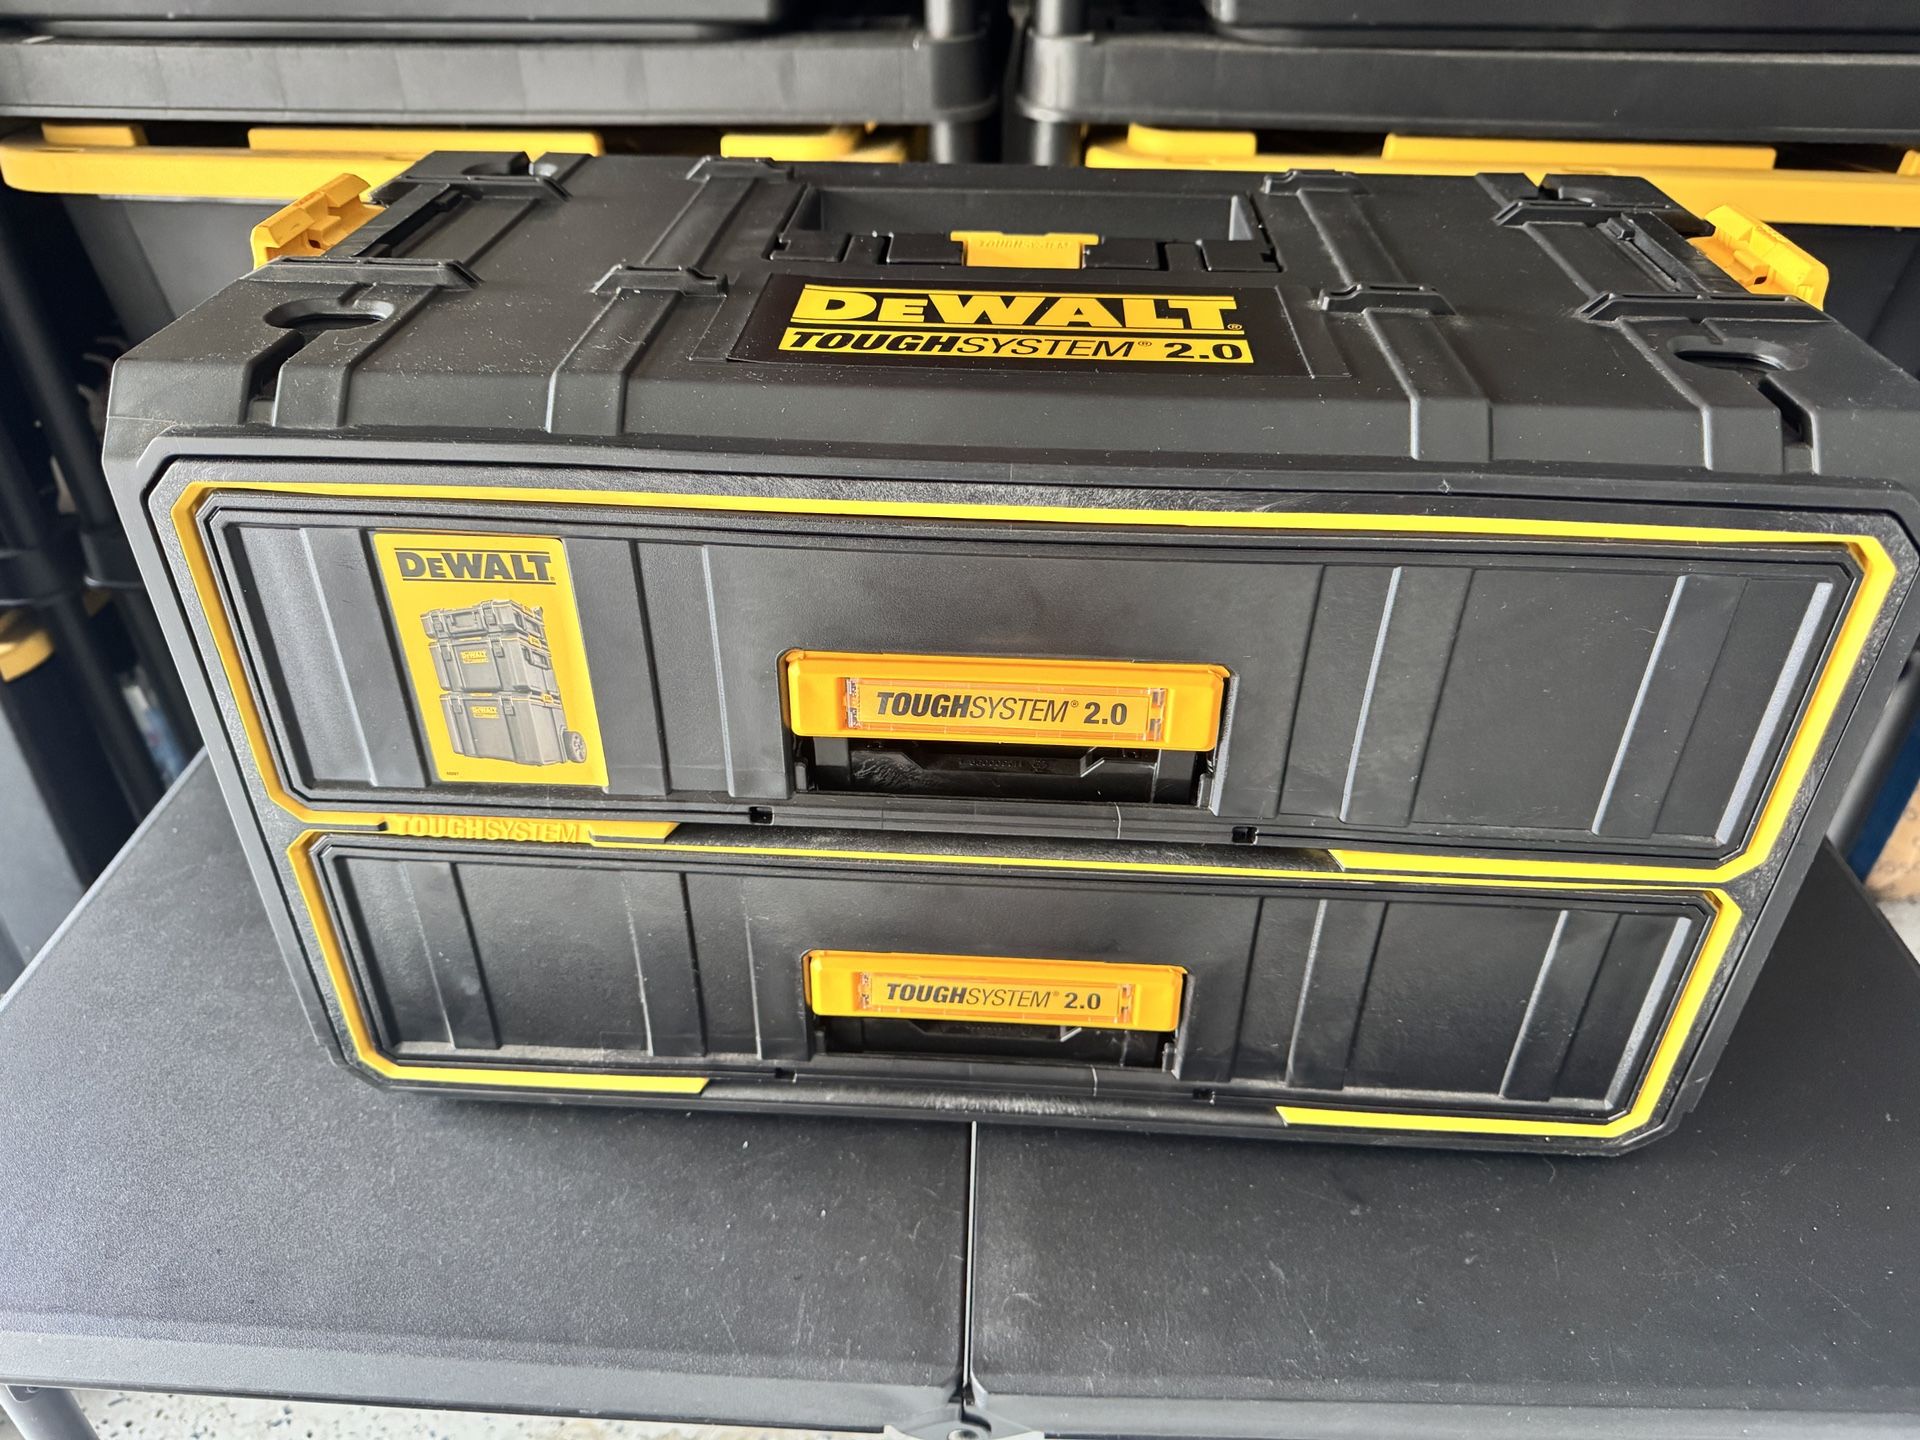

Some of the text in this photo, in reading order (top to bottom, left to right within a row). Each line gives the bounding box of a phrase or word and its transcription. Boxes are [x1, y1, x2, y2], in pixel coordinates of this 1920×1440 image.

[1164, 342, 1242, 360] 2.0
[1084, 702, 1128, 726] 2.0
[395, 815, 581, 844] TOUGHSYSTEM
[1064, 992, 1101, 1010] 2.0
